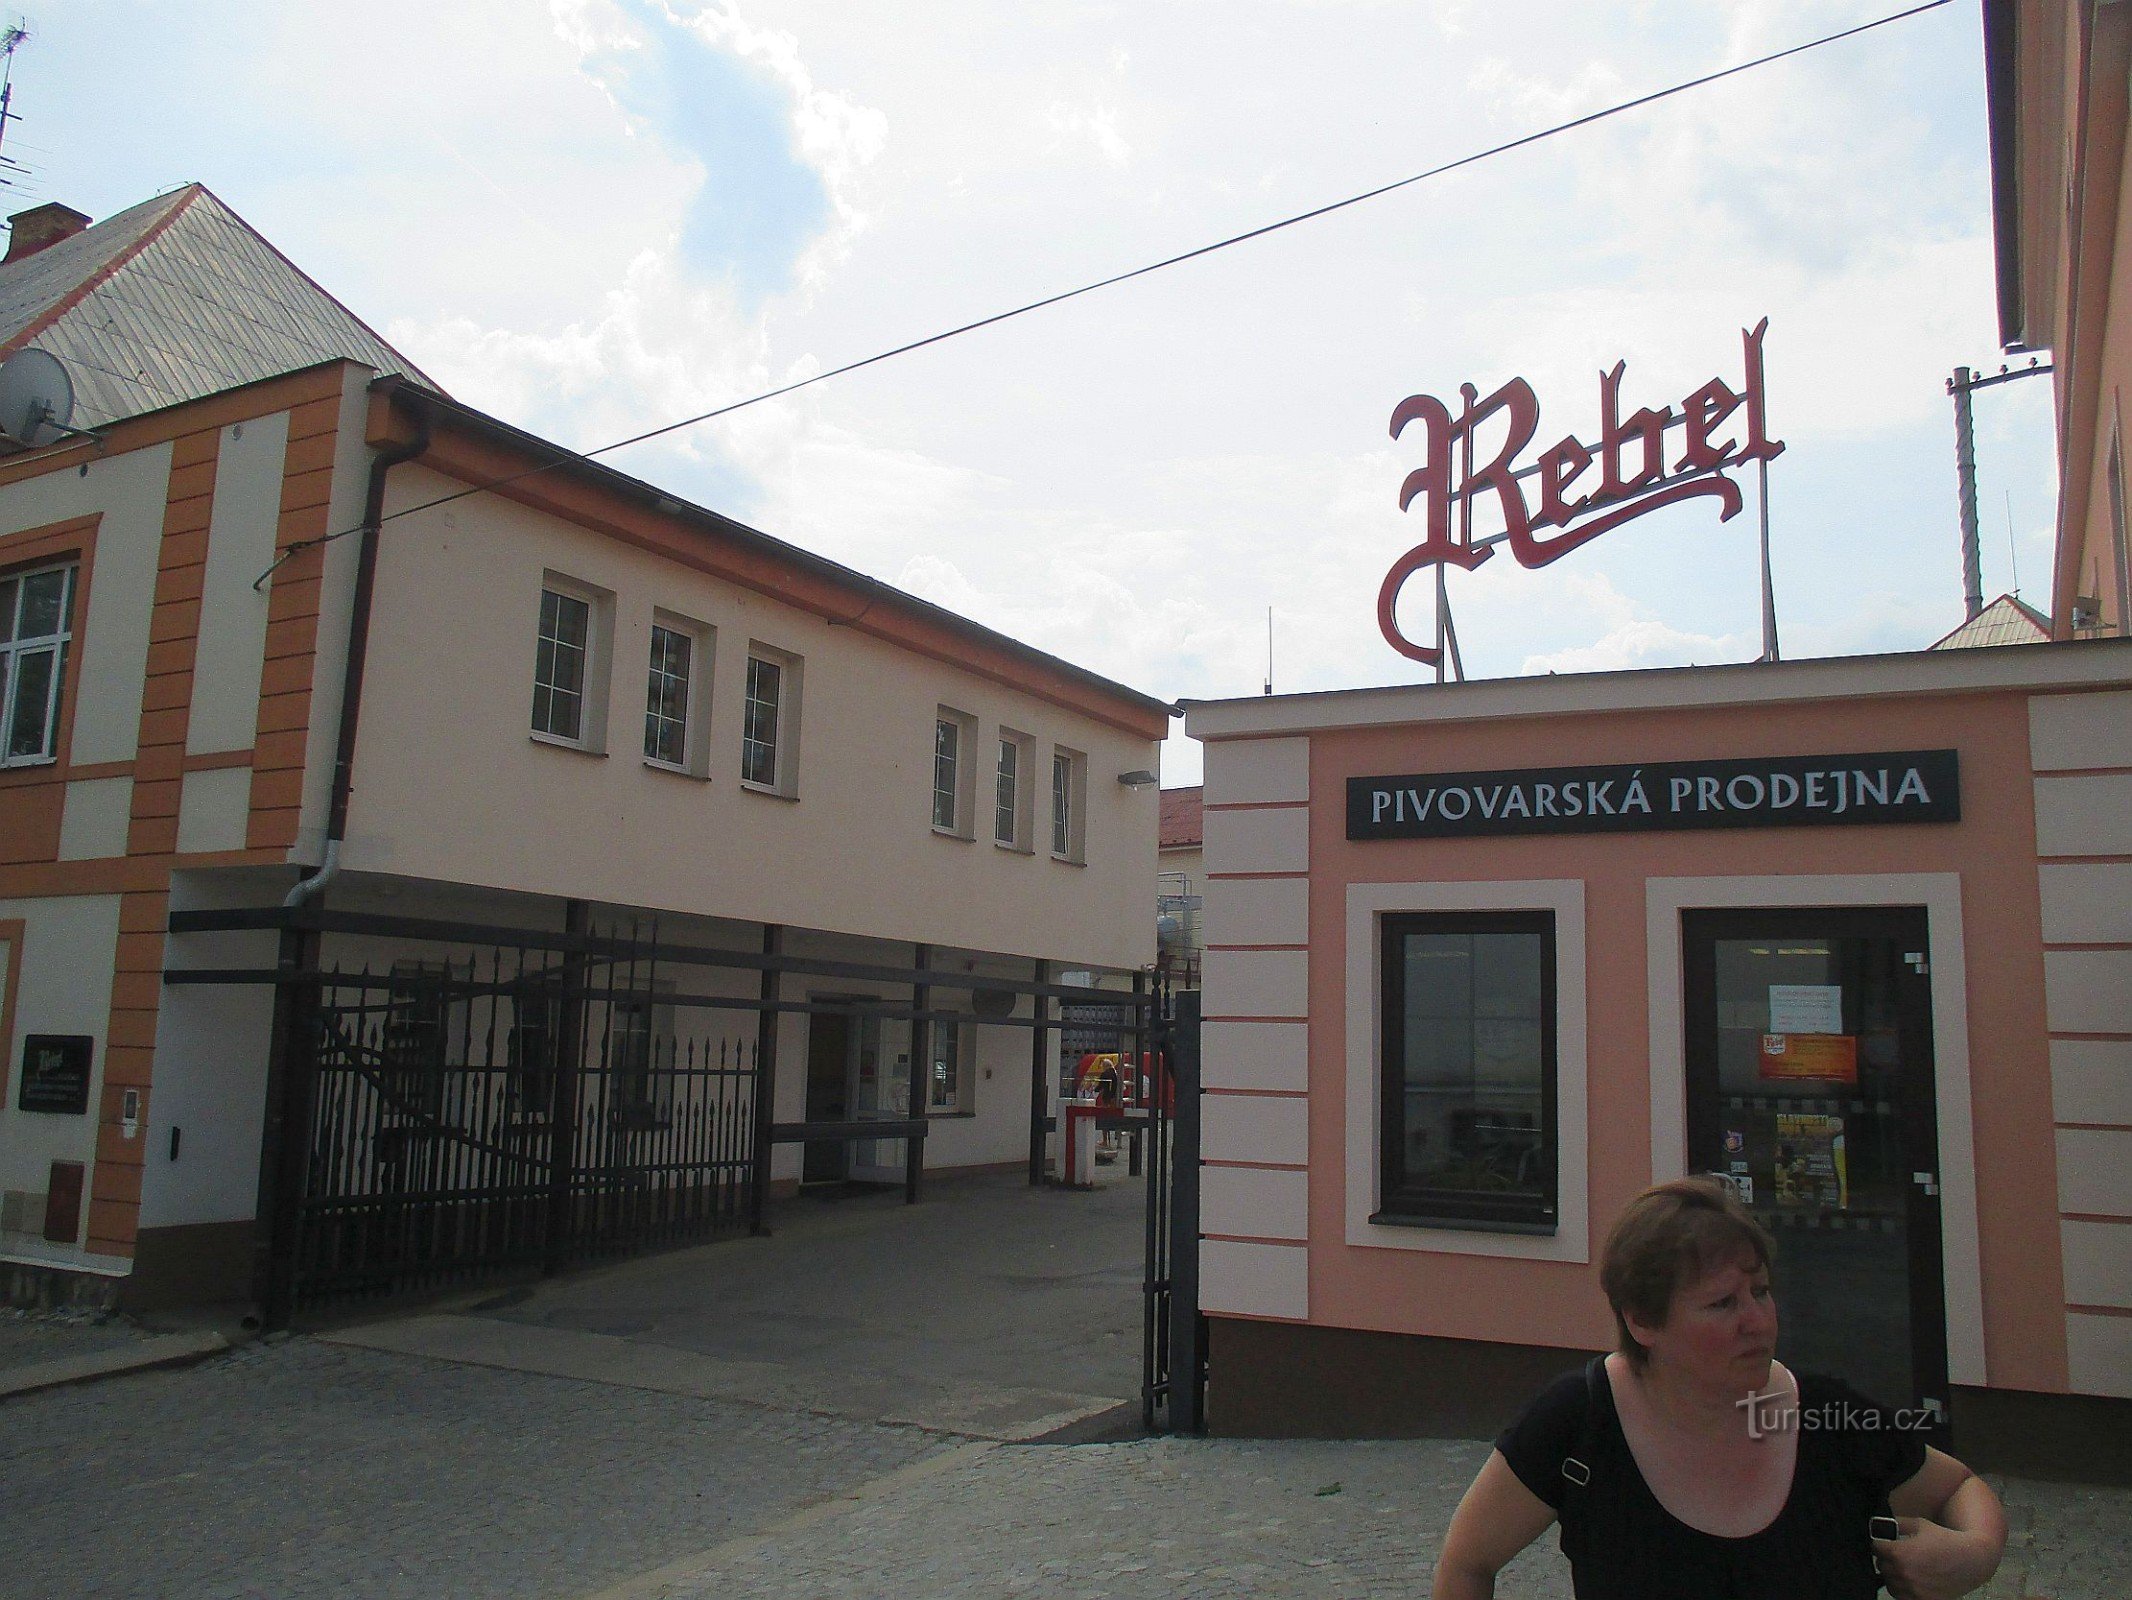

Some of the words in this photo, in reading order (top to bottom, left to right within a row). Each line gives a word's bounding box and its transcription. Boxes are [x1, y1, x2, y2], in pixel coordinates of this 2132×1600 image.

[1377, 316, 1786, 668] Rebel
[1371, 769, 1653, 823] PIVOVARSKÁ
[1670, 767, 1931, 814] PRODEJNA
